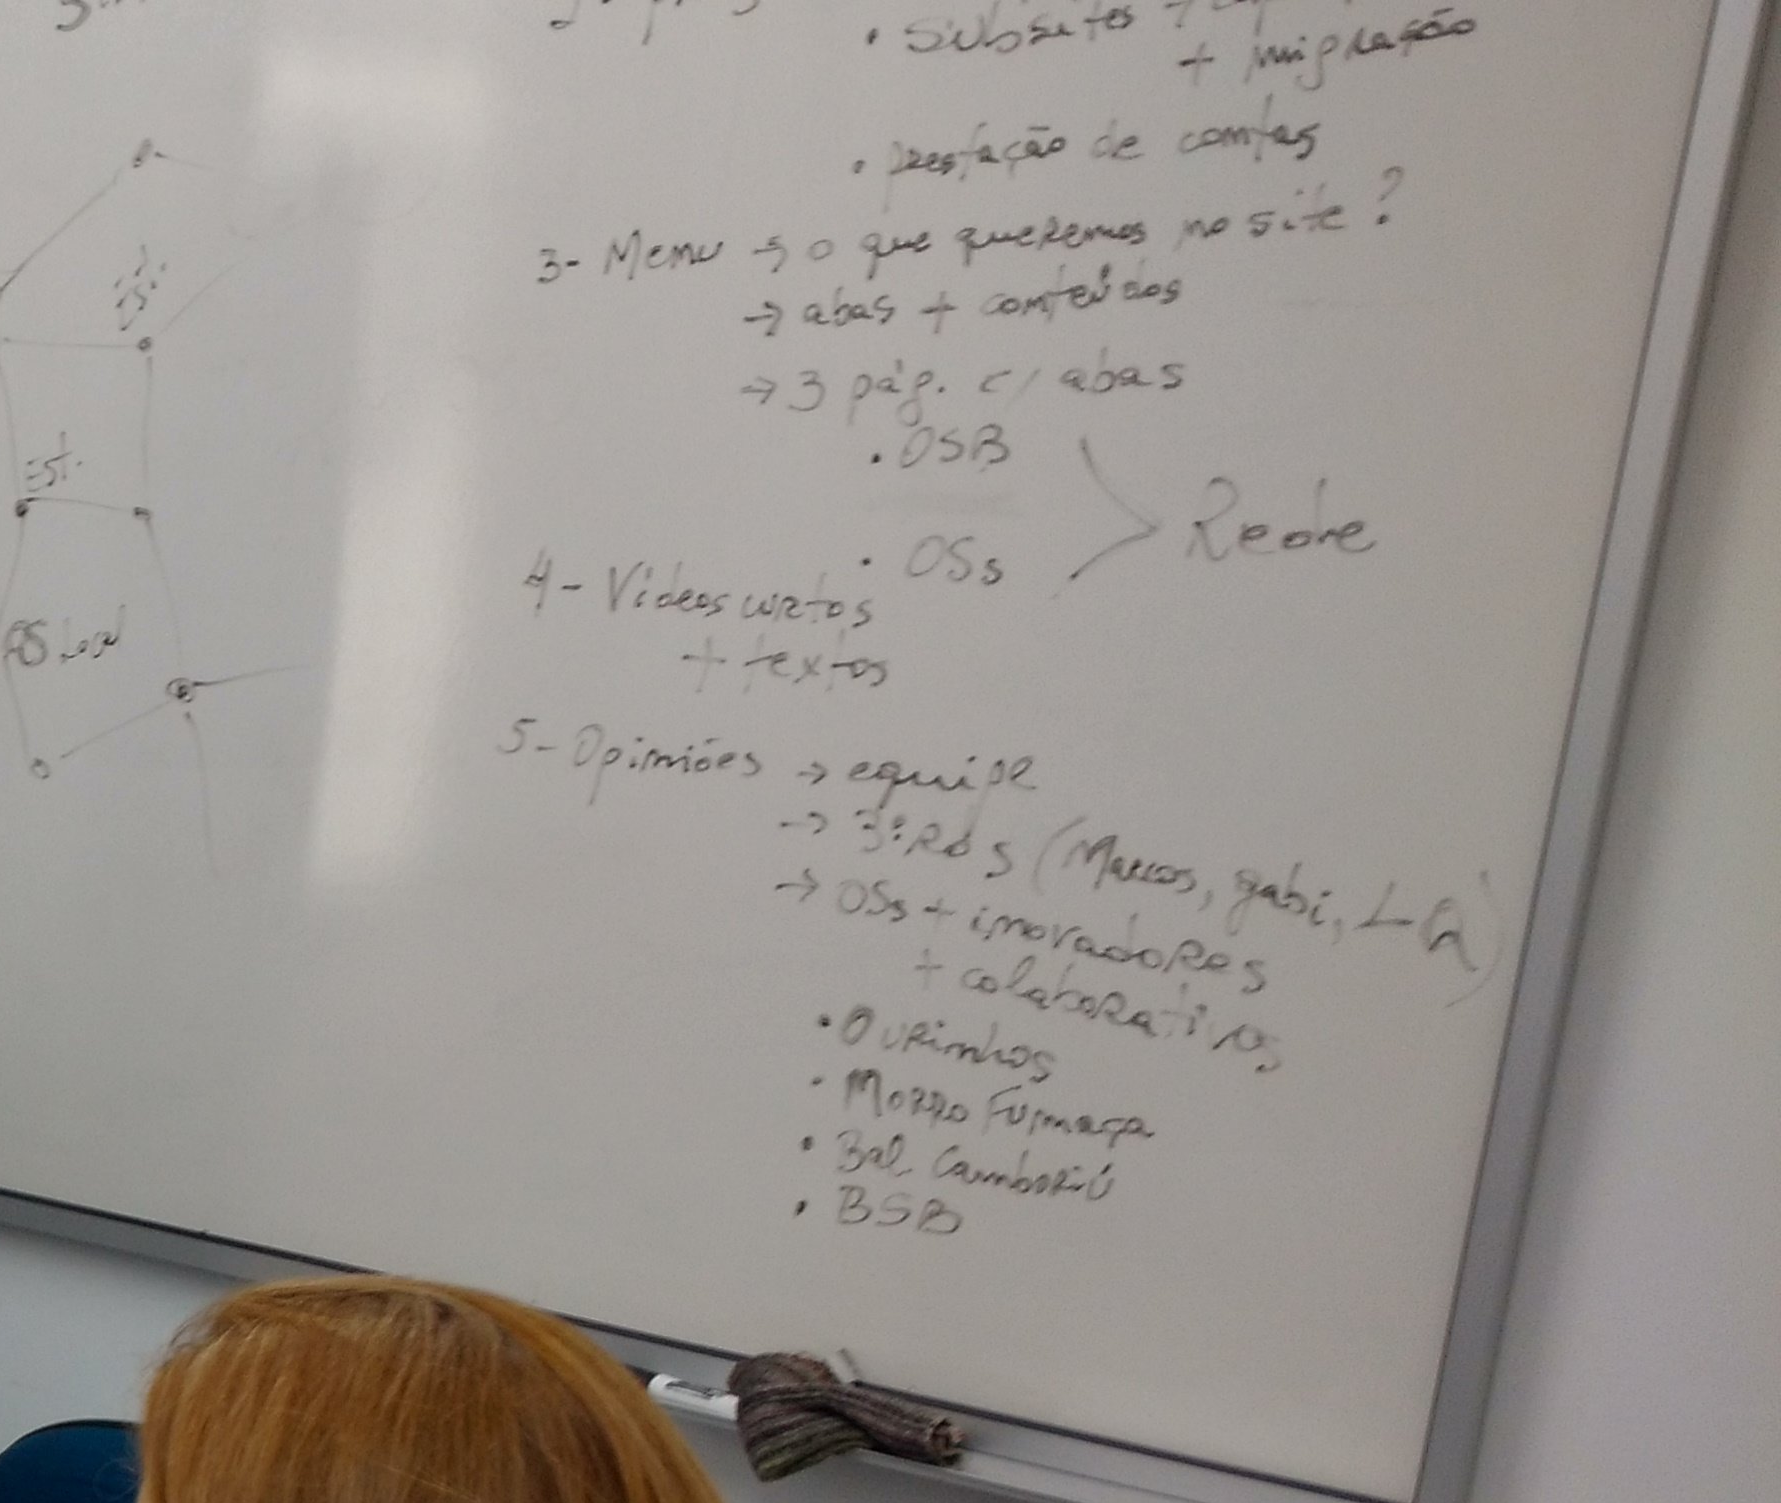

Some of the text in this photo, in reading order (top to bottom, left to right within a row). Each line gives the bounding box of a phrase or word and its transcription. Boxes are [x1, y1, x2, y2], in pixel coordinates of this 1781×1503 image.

[1091, 118, 1145, 161] de
[602, 228, 725, 281] Menu
[859, 230, 932, 280] que
[1174, 214, 1230, 252] no
[801, 286, 896, 326] abas
[1059, 346, 1186, 395] abas
[899, 422, 1012, 472] OSB
[742, 630, 890, 696] textos
[837, 1184, 965, 1236] BSB
